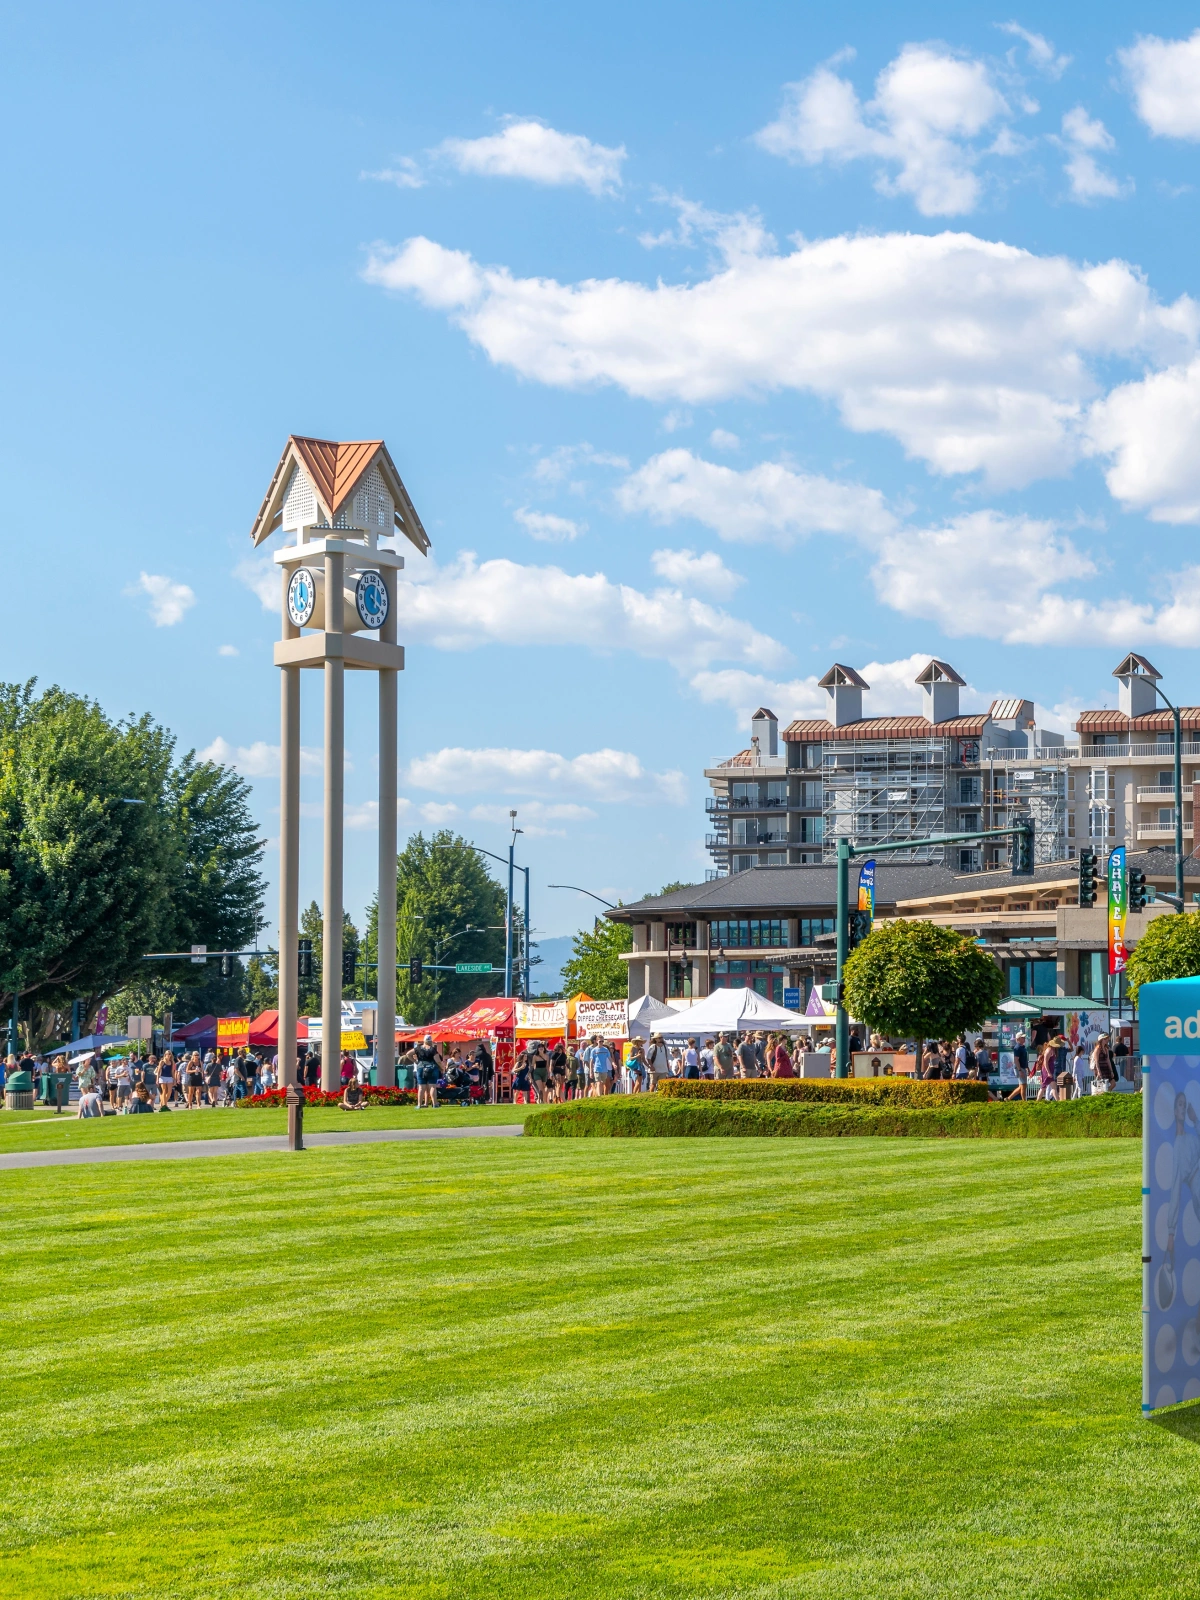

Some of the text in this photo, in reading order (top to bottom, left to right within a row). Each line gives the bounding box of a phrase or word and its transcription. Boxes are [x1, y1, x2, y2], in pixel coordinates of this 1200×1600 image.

[1112, 854, 1126, 971] SHAVE ICE
[532, 1008, 564, 1022] ELOTES
[580, 1002, 624, 1014] CHOCOLATE
